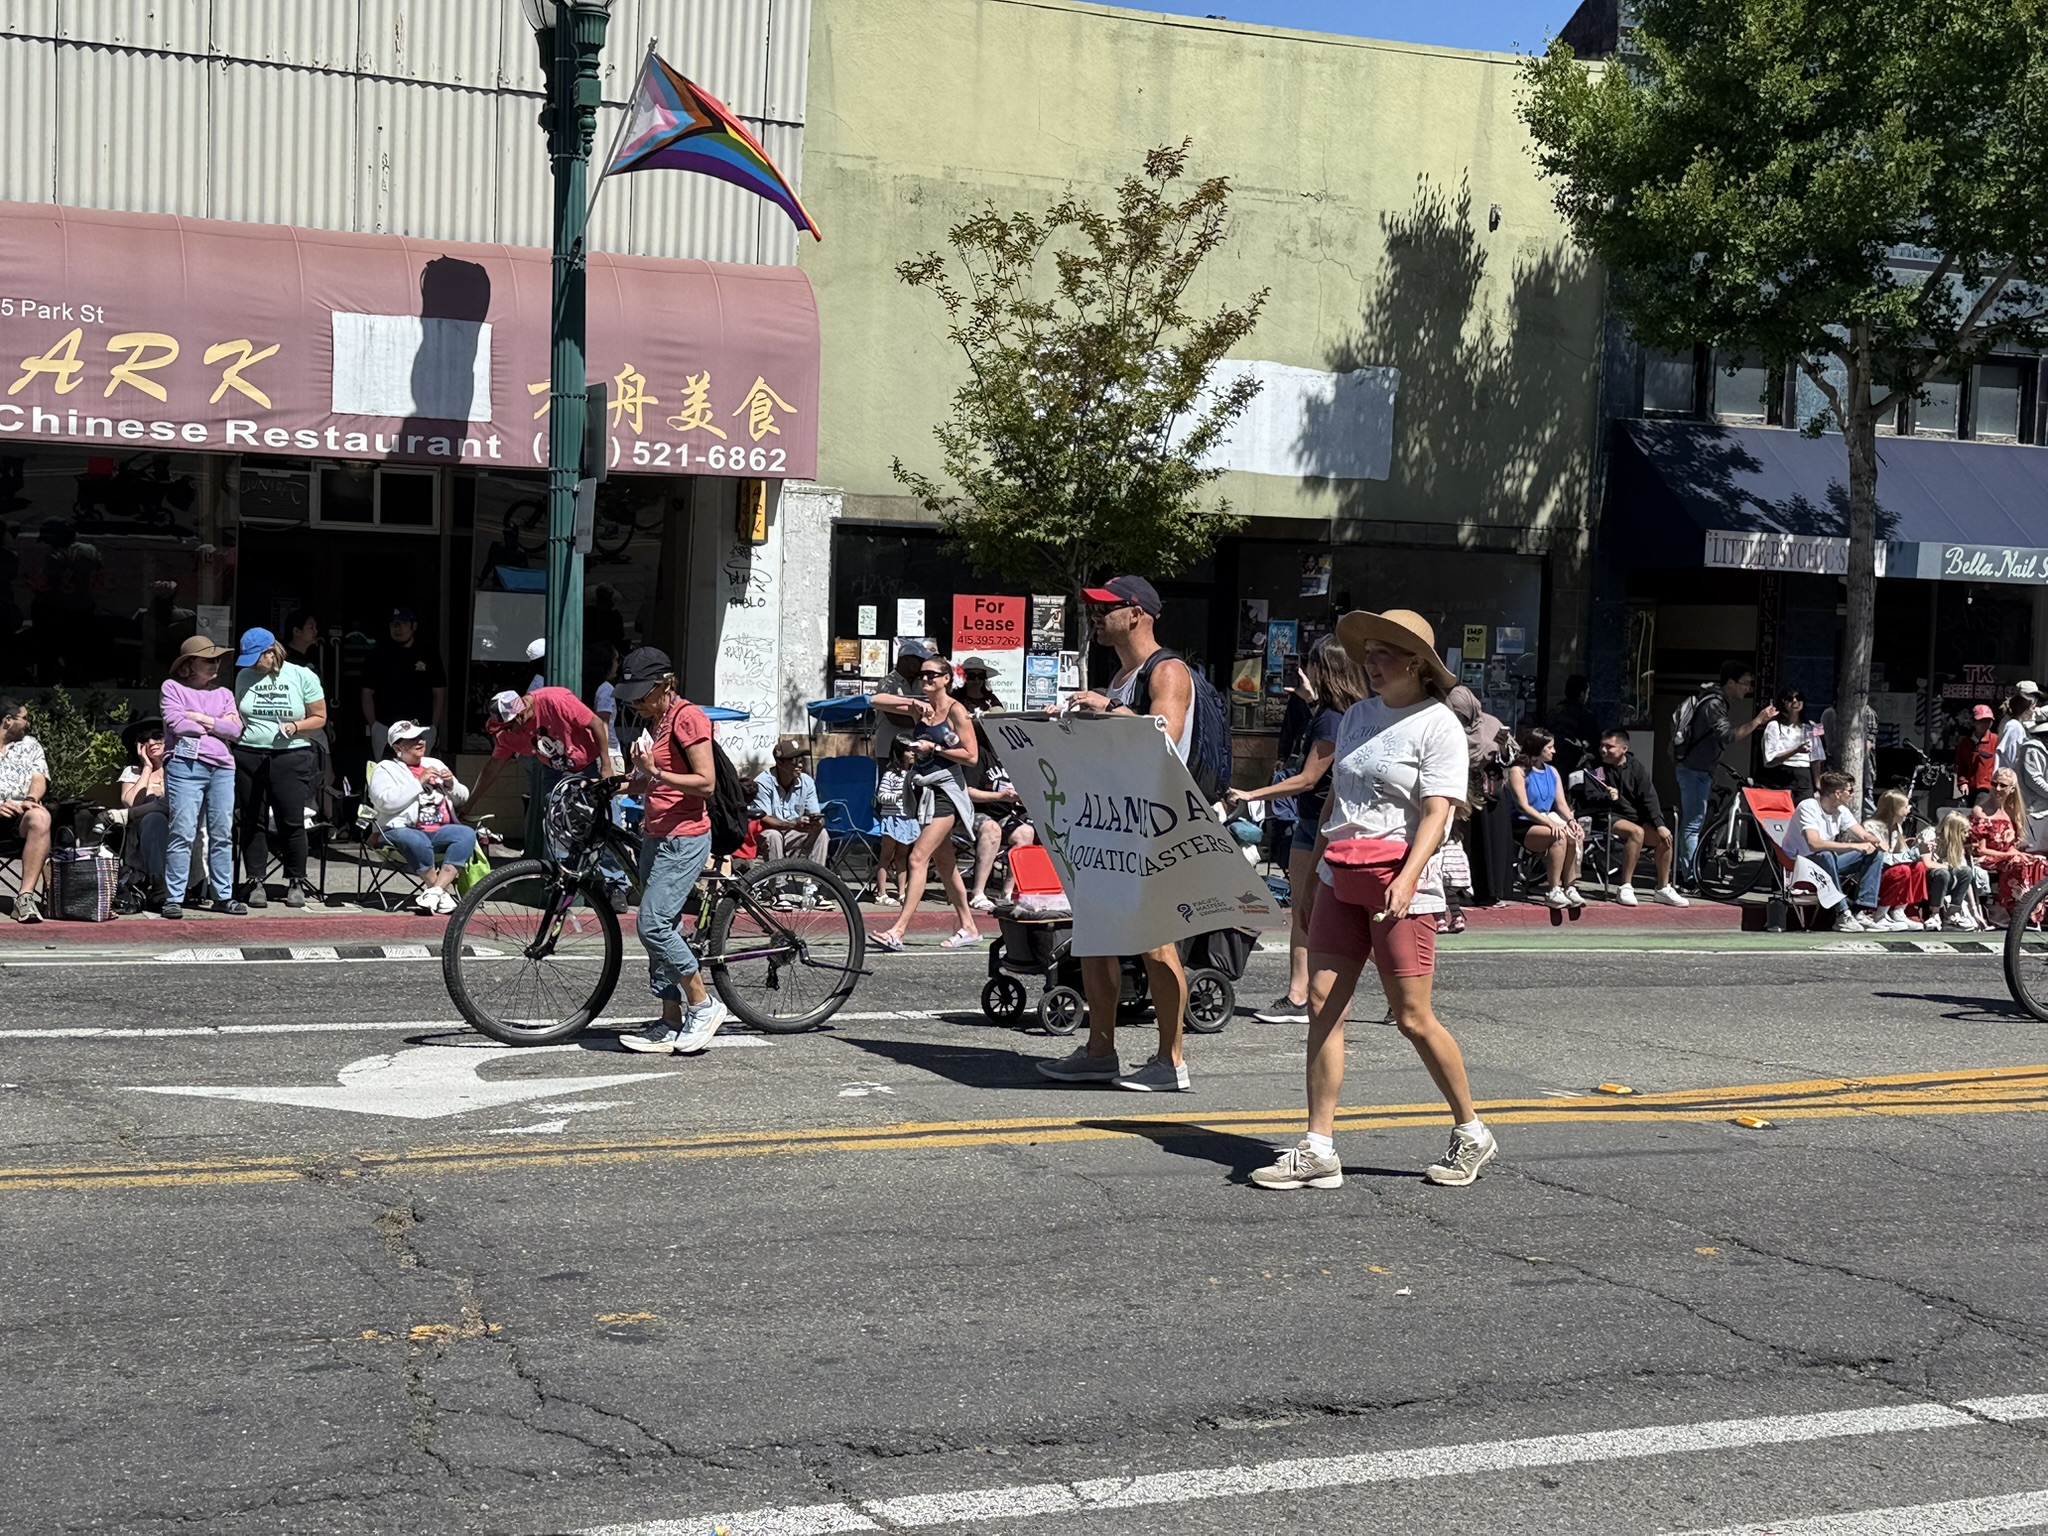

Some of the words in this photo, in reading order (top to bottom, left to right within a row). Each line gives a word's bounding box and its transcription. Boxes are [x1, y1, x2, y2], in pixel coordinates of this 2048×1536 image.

[21, 300, 74, 322] Park
[80, 305, 104, 323] St
[0, 404, 209, 443] Chinese
[225, 419, 502, 459] Restaurant
[632, 440, 787, 472] 521-6862
[1945, 547, 1994, 577] Bella
[1994, 550, 2038, 578] Nail
[975, 598, 1005, 614] For
[963, 615, 1015, 632] Lease
[957, 634, 1021, 647] 415.395.7262
[1962, 664, 1996, 684] TK
[999, 725, 1034, 750] 104
